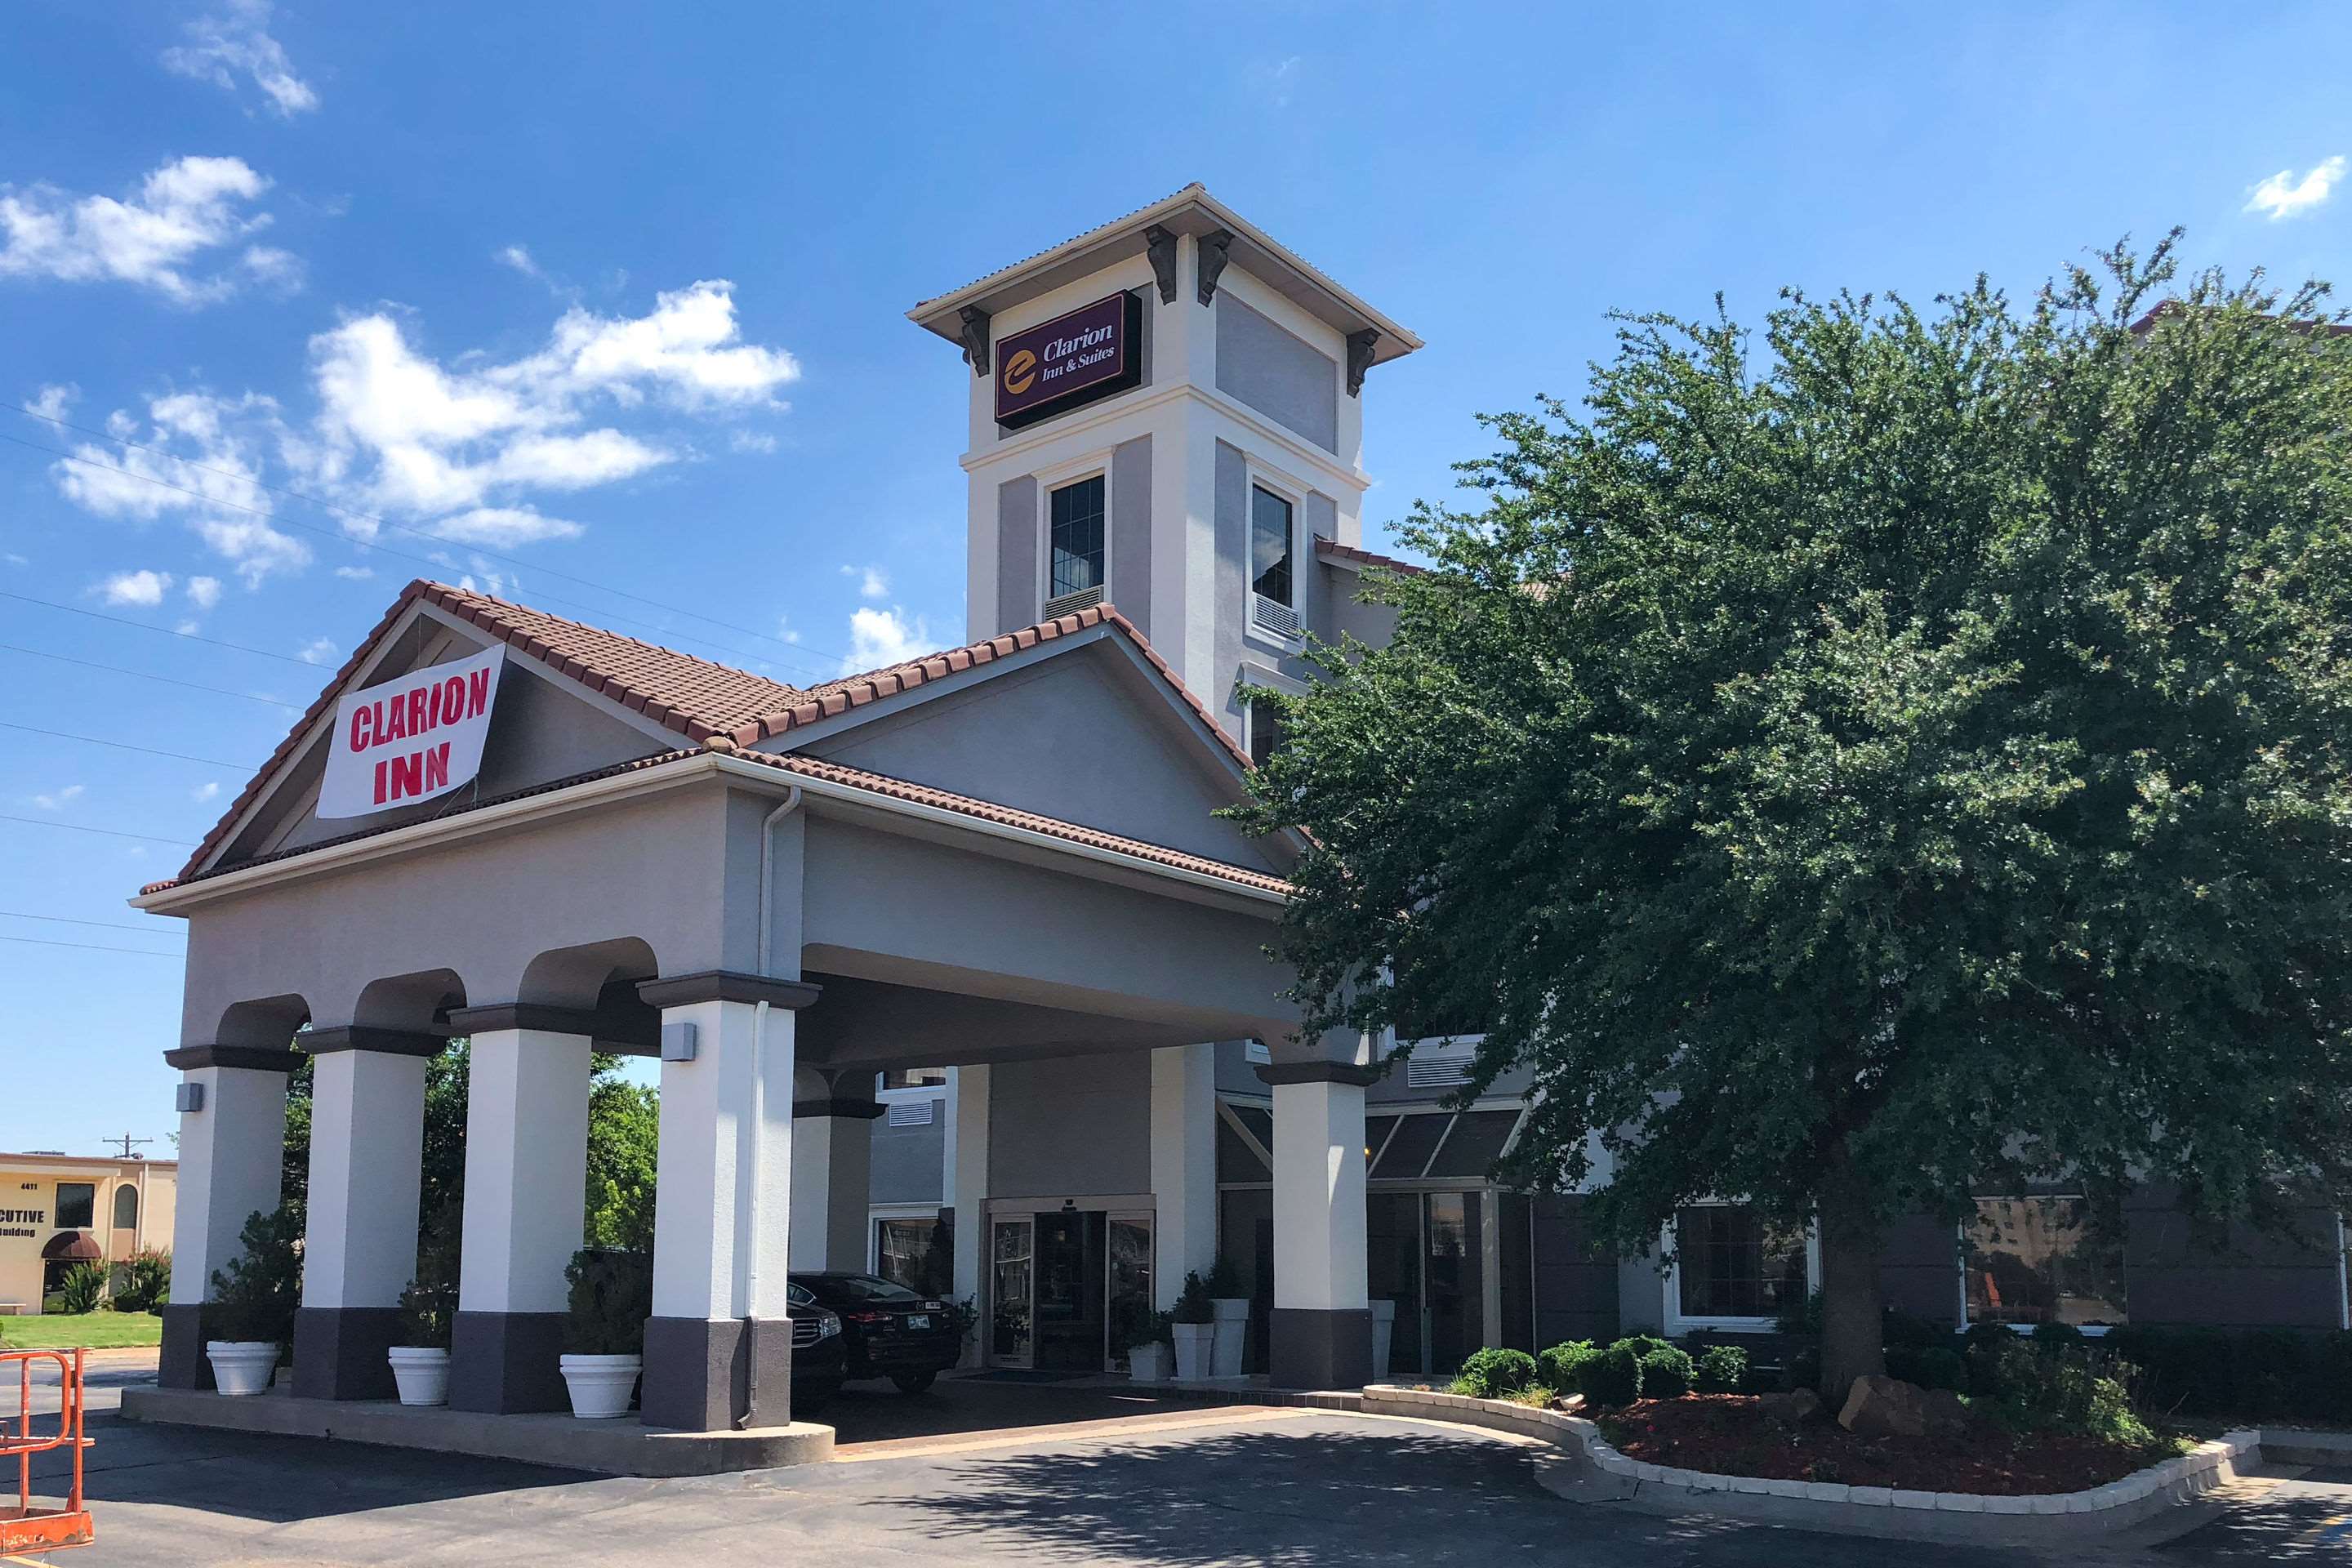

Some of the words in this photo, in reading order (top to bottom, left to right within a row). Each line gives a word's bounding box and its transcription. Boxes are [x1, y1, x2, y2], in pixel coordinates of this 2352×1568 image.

[1044, 324, 1112, 362] Clarion
[1042, 365, 1063, 382] Inn
[1066, 359, 1077, 372] &
[1077, 346, 1115, 368] Suites
[350, 667, 490, 753] CLARION
[373, 742, 451, 805] INN
[0, 1227, 35, 1238] uilding
